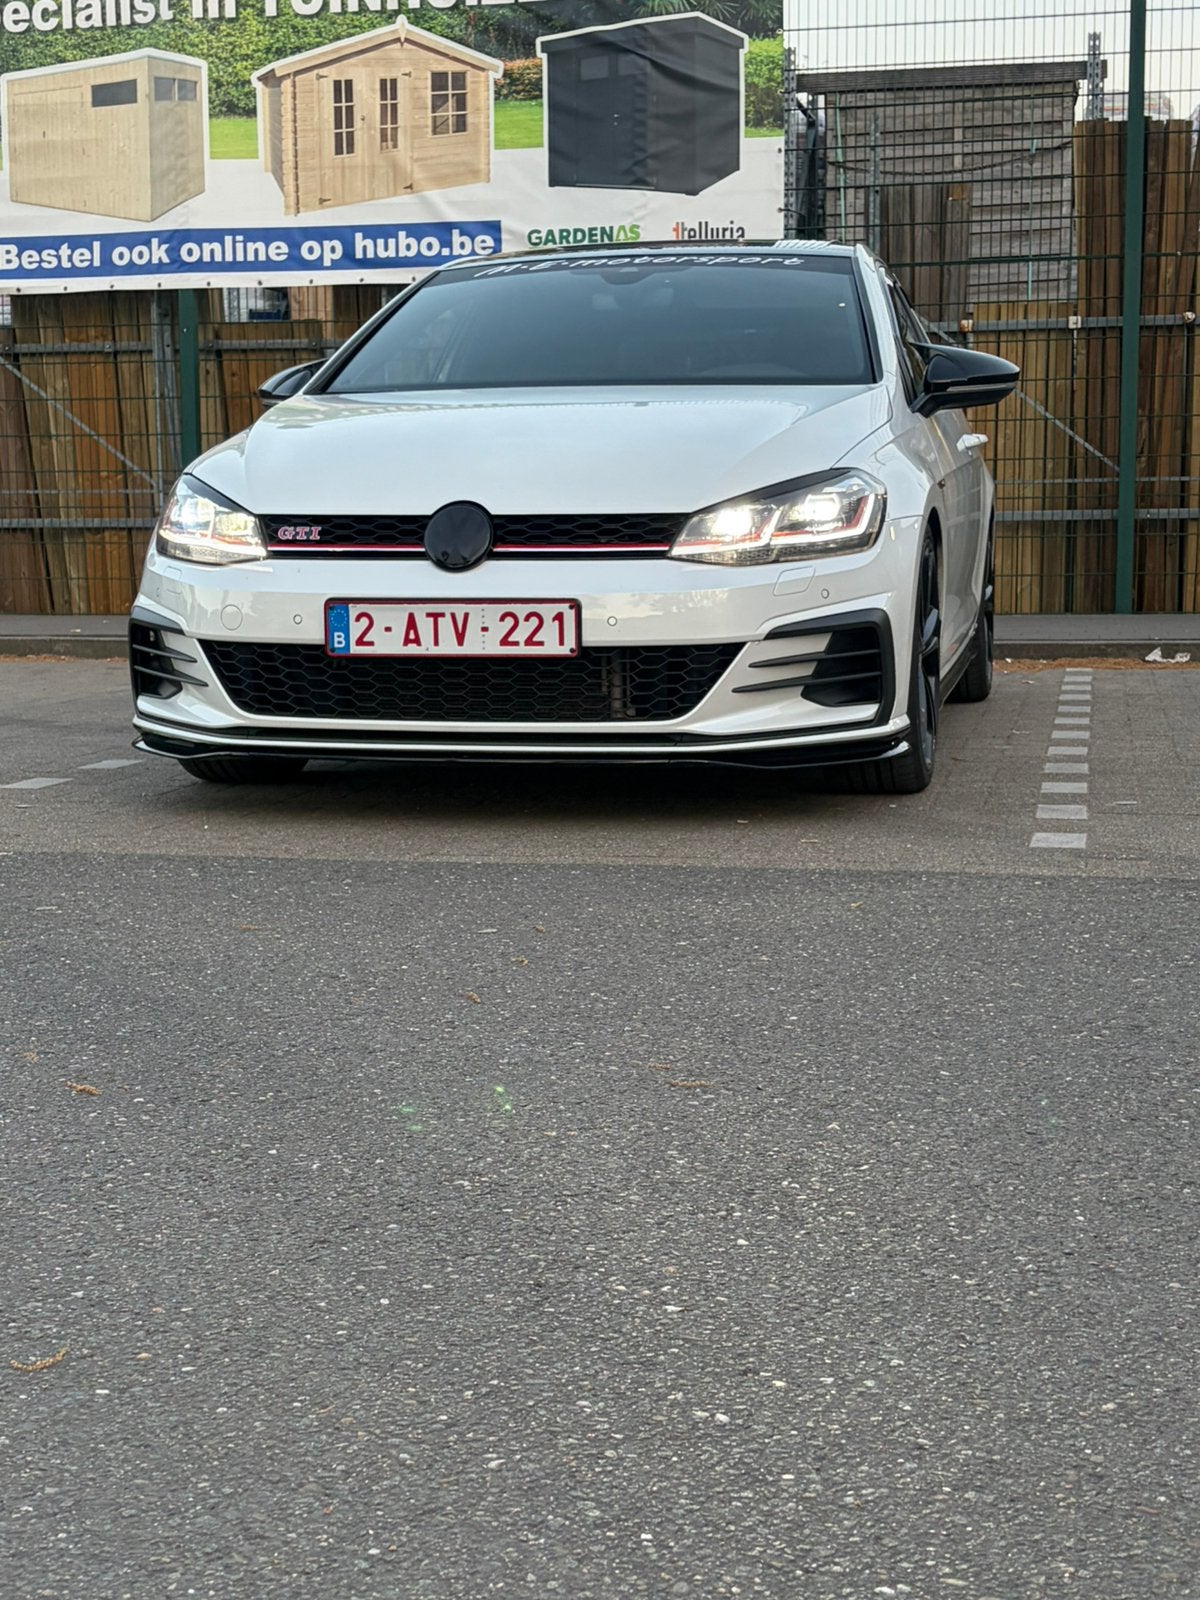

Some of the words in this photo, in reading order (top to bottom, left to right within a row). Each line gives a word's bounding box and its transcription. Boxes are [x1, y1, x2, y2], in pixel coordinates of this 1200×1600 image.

[527, 223, 641, 247] GARDENAS
[0, 241, 101, 270] Bestel
[111, 238, 170, 266] ook
[180, 235, 289, 263] online
[300, 239, 343, 267] op
[355, 229, 495, 259] hubo.be
[277, 525, 322, 541] GTI
[333, 631, 346, 648] B
[354, 611, 565, 647] 2-ATV-221
